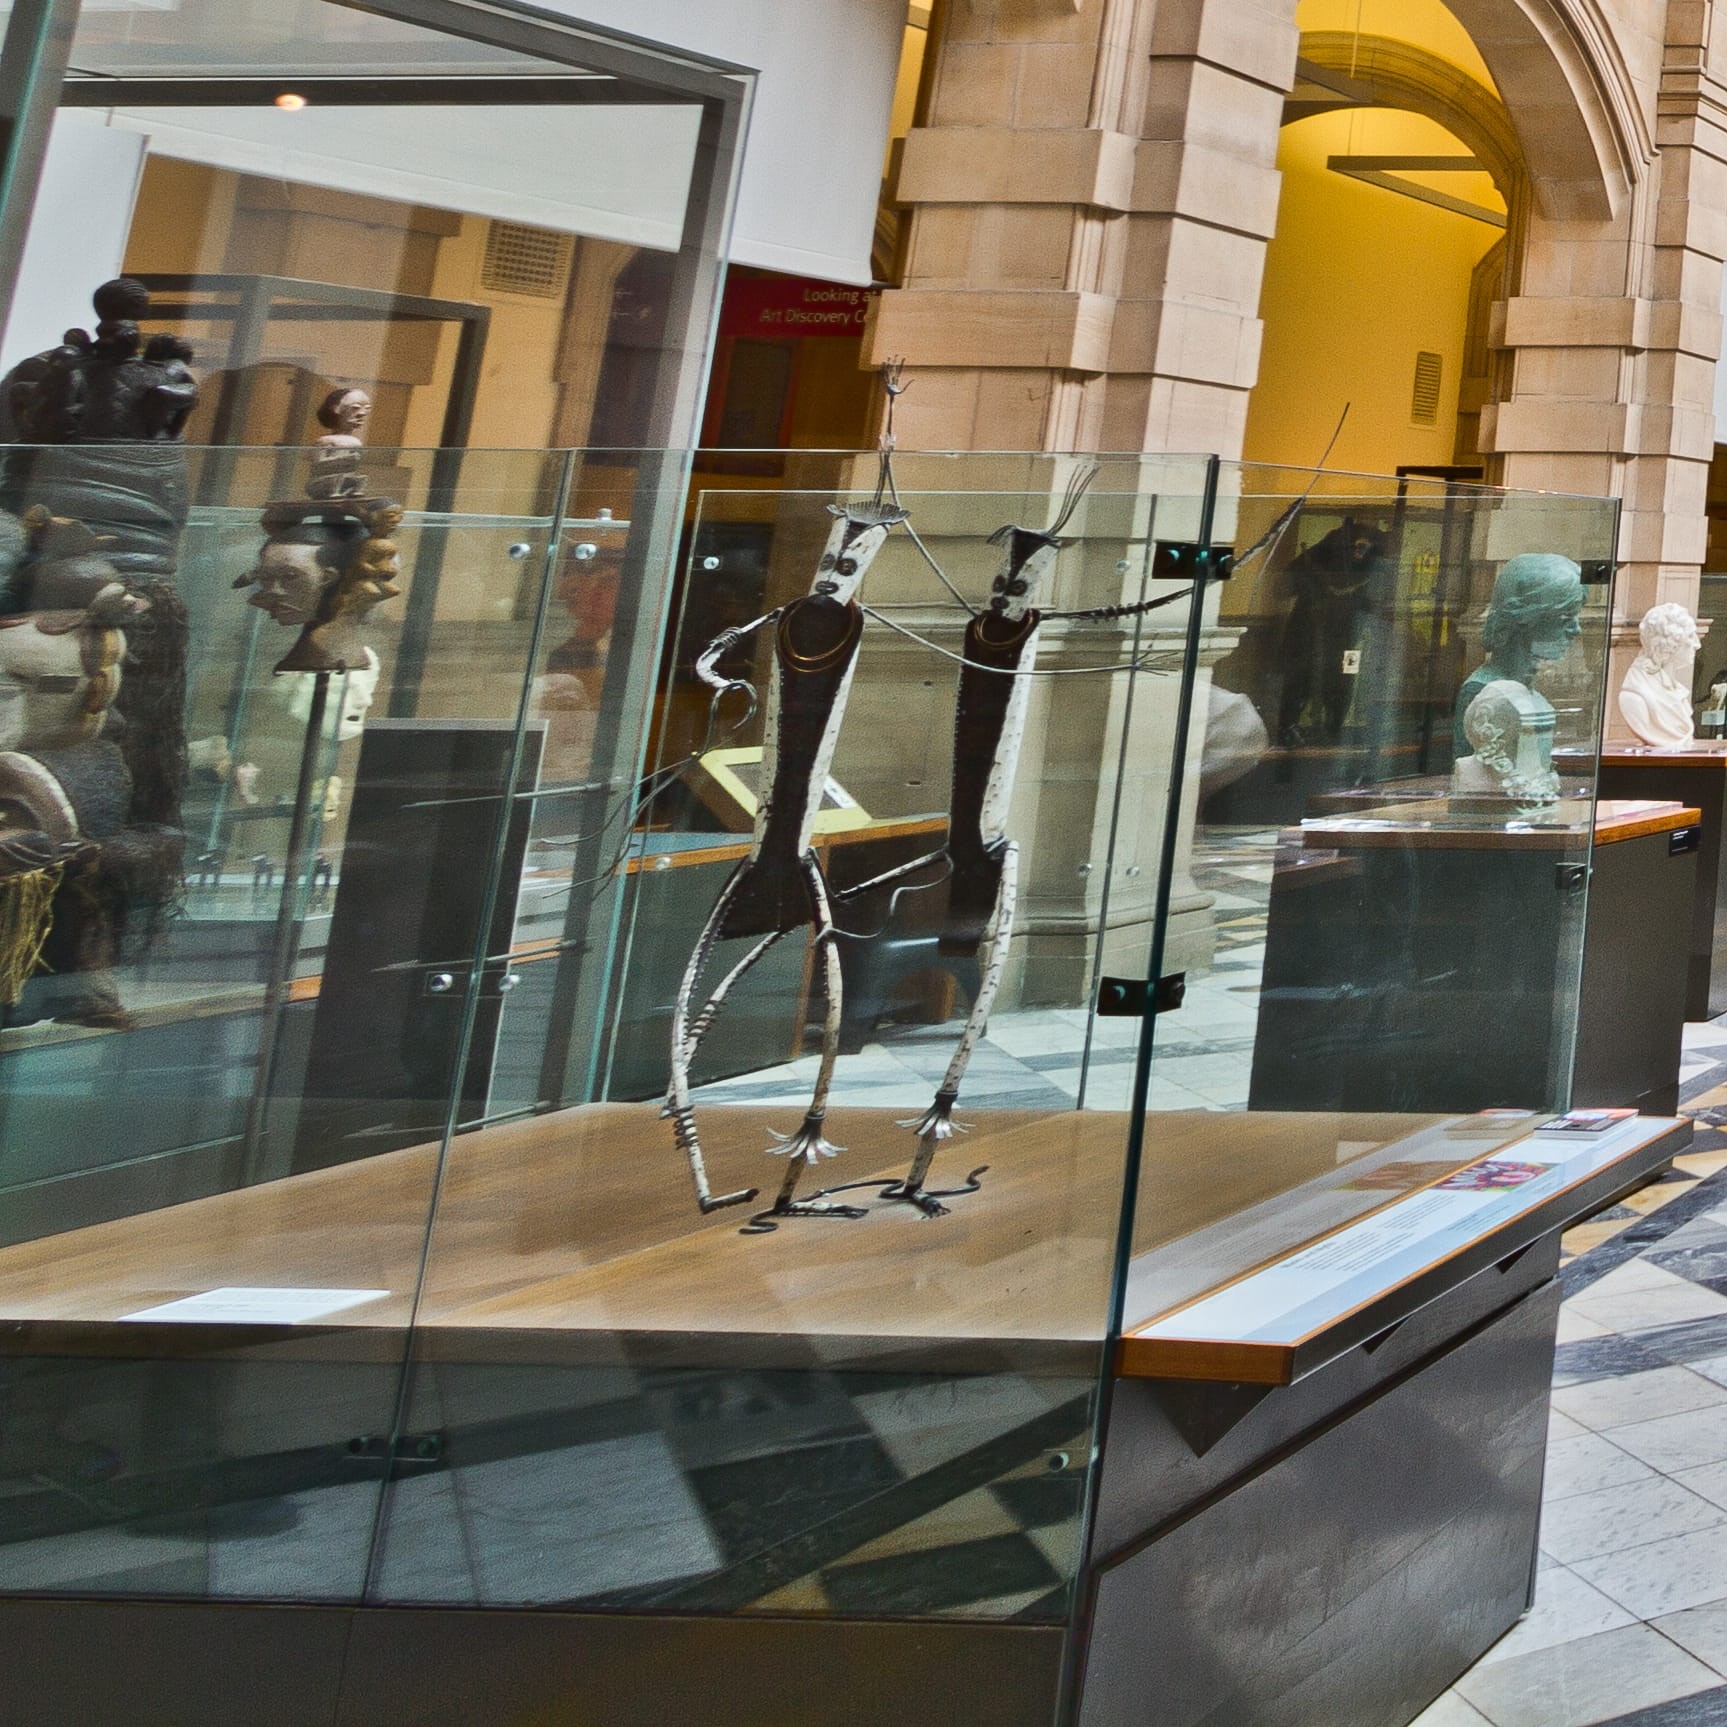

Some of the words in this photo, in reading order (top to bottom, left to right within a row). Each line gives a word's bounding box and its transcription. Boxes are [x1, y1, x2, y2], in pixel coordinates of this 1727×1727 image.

[804, 288, 859, 304] Looking
[760, 308, 783, 322] Art
[786, 309, 850, 325] Discovery
